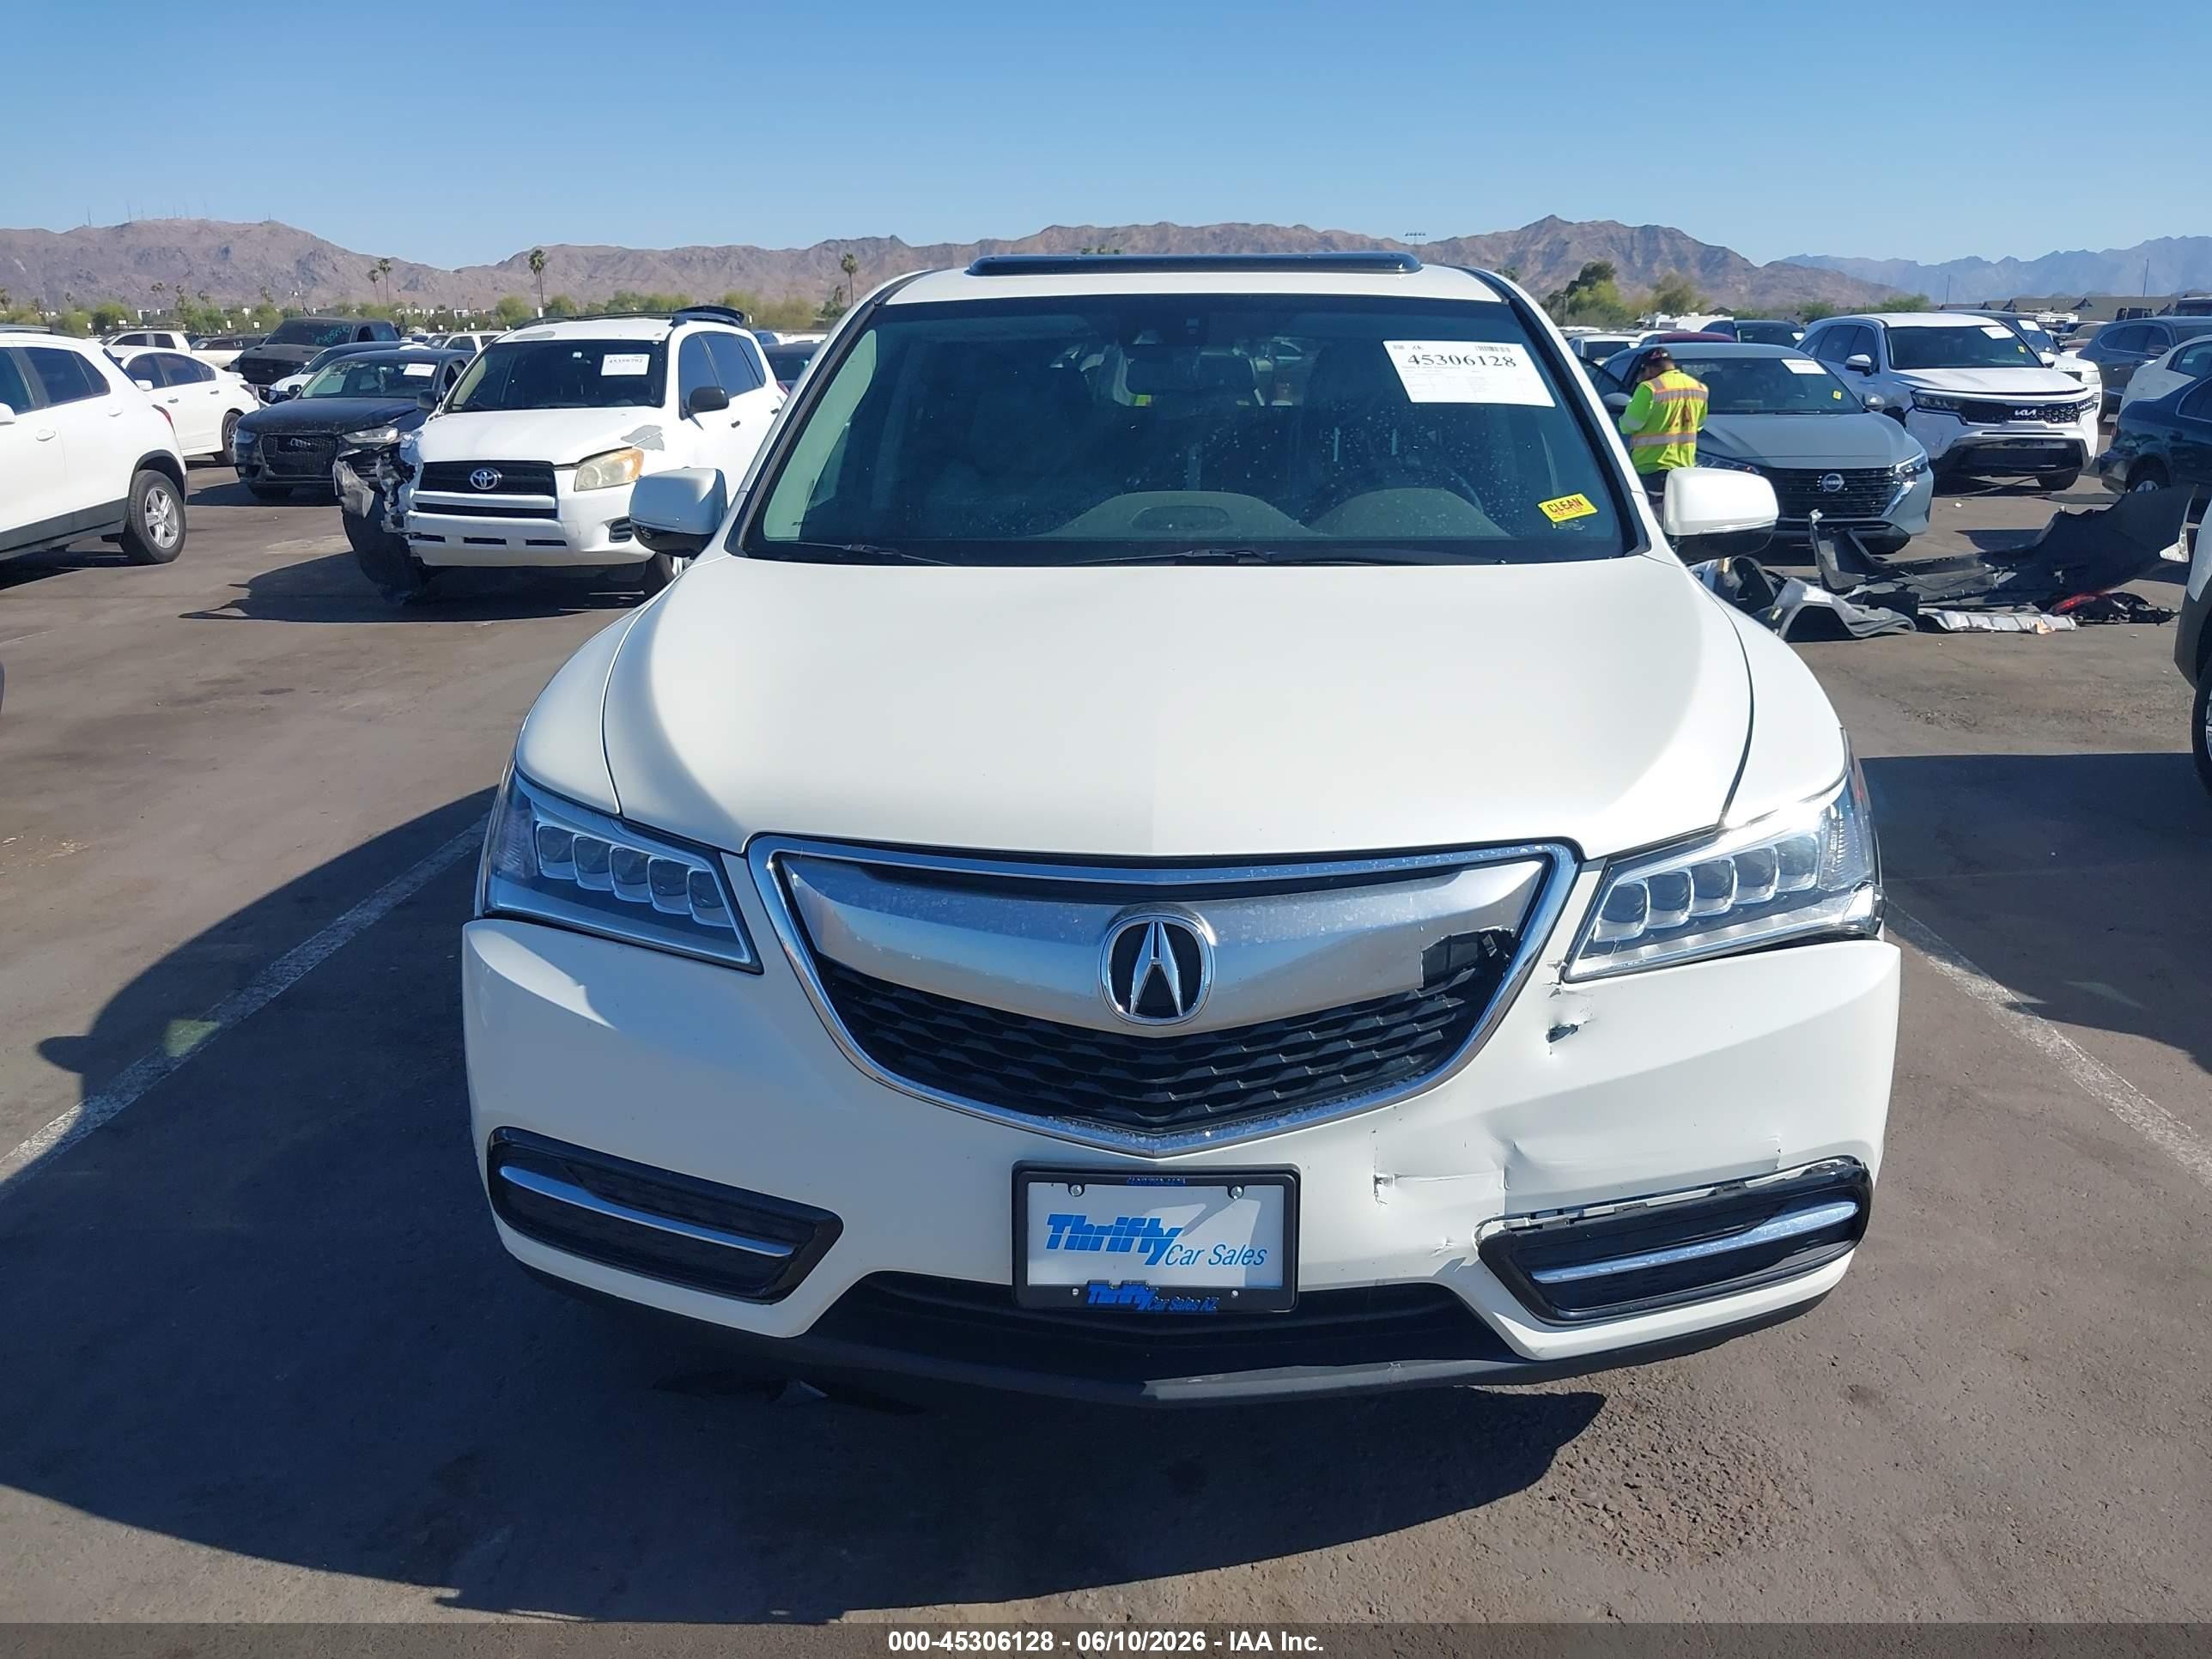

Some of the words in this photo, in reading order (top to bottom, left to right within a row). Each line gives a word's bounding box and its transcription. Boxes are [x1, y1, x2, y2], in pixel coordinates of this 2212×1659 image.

[1407, 354, 1516, 368] 45306128
[1547, 498, 1584, 513] CLEAN
[1046, 1213, 1183, 1266] Thrifty
[1164, 1245, 1206, 1266] Car
[1207, 1243, 1267, 1266] Sales
